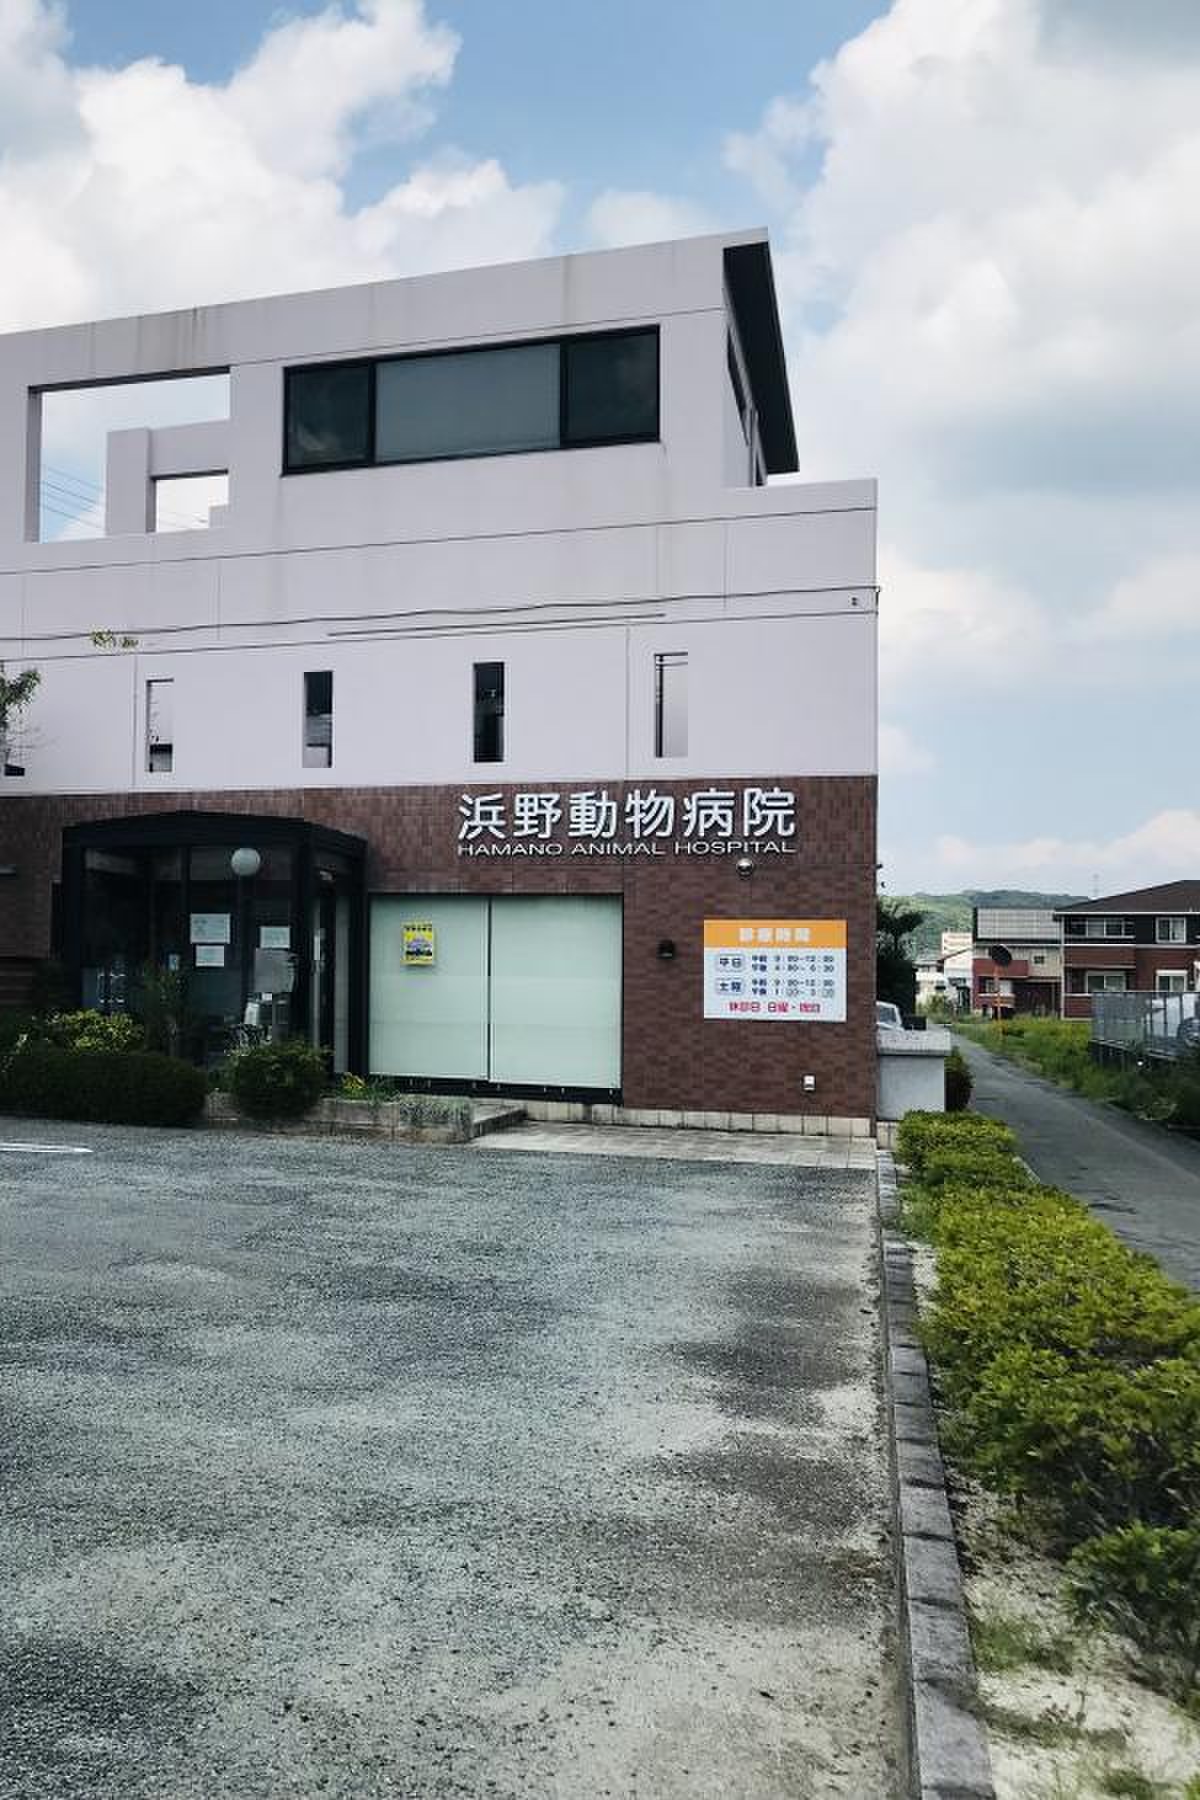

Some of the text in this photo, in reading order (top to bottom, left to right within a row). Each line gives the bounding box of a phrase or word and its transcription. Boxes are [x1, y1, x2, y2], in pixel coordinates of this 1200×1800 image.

[458, 787, 796, 840] 浜野動物病院
[458, 841, 798, 856] HAMANO ANIMAL HOSPITAL
